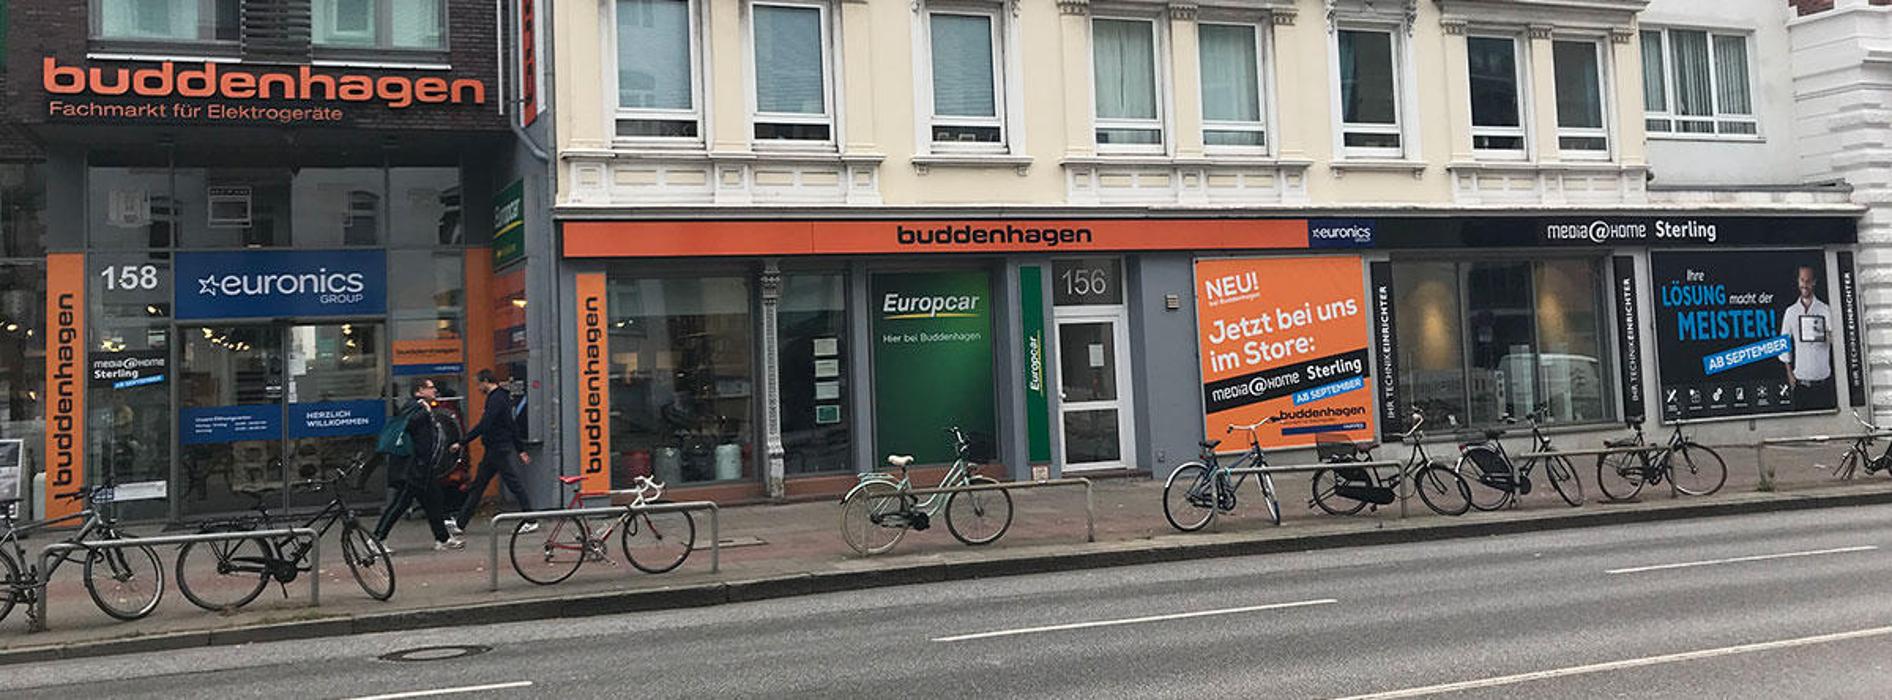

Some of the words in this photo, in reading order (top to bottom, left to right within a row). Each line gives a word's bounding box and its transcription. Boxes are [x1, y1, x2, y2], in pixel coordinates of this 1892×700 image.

[43, 57, 485, 108] buddenhagen
[49, 101, 166, 118] Fachmarkt
[172, 103, 201, 119] für
[208, 104, 343, 122] Elektrogeräte
[897, 224, 1093, 246] buddenhagen
[1320, 224, 1371, 239] euronics
[1654, 220, 1717, 242] Sterling
[100, 265, 159, 290] 158
[220, 268, 365, 295] euronics
[1061, 268, 1106, 295] 156
[1205, 271, 1259, 299] NEU!
[1686, 269, 1705, 282] Ihre
[320, 295, 364, 304] GROUP
[883, 293, 980, 317] Europcar
[1661, 280, 1726, 306] LÖSUNG
[1729, 293, 1757, 305] macht
[1758, 292, 1774, 304] der
[1209, 316, 1273, 345] Jetzt
[1277, 302, 1313, 330] bei
[1317, 298, 1358, 321] uns
[1677, 308, 1777, 341] MEISTER!
[883, 334, 902, 343] Hier
[904, 333, 918, 343] bei
[920, 332, 982, 344] Buddenhagen
[1029, 335, 1038, 392] Europcar
[1210, 350, 1241, 373] im
[1244, 336, 1316, 366] Store:
[1708, 356, 1725, 371] AB
[1727, 338, 1788, 366] SEPTEMBER
[93, 368, 139, 380] Sterling
[1307, 359, 1362, 381] Sterling
[52, 292, 77, 488] buddenhagen
[584, 296, 602, 474] buddenhagen
[1296, 392, 1310, 403] AB
[1310, 379, 1362, 399] SEPTEMBER
[306, 410, 351, 419] HERZLICH
[306, 417, 369, 428] WILLKOMMEN
[1280, 406, 1365, 421] buddenhagen
